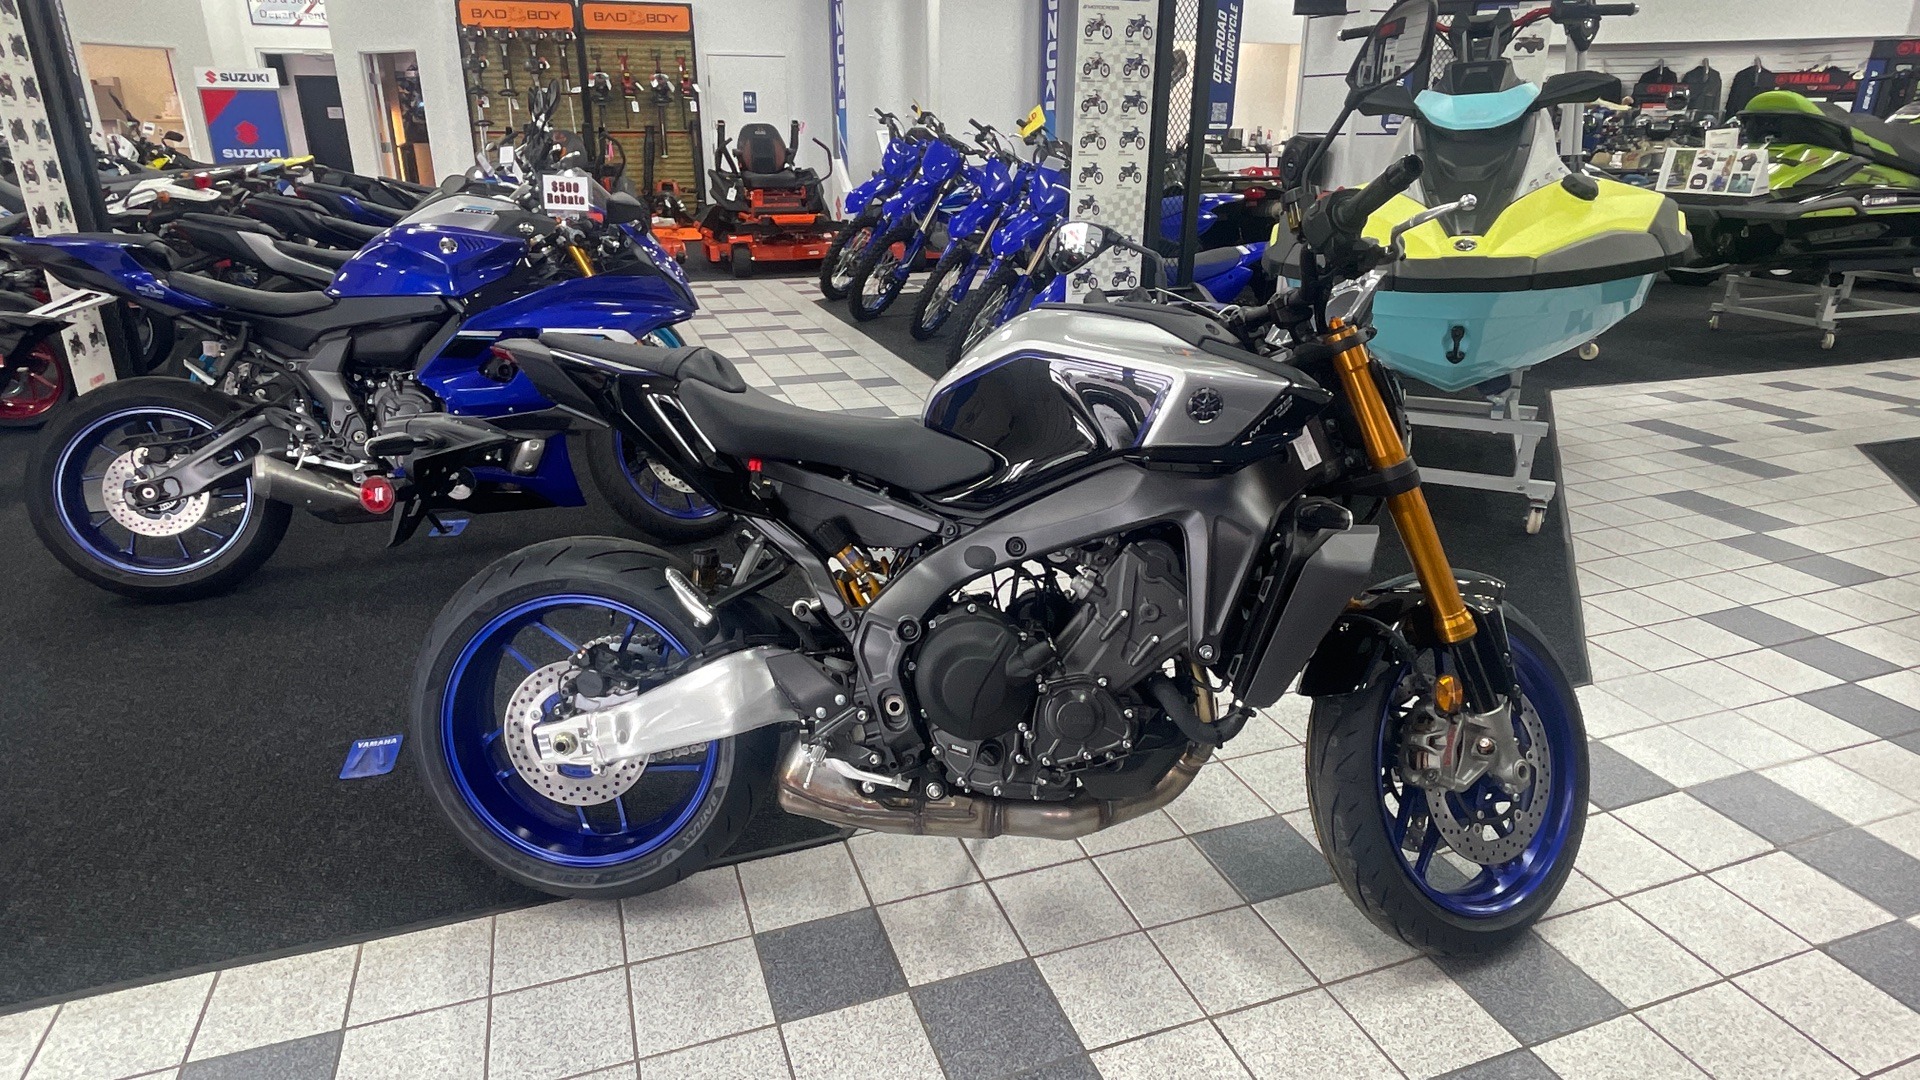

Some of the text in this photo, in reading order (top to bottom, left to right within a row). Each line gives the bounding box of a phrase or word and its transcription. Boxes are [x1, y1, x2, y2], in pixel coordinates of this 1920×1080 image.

[471, 8, 561, 21] BAD BOY
[593, 11, 679, 23] BAD BOY
[1212, 9, 1228, 84] OFF-ROAD
[1223, 2, 1239, 84] MOTORCYCLE
[836, 0, 845, 109] ZUKI
[220, 72, 269, 83] SUZUKI
[1788, 73, 1830, 84] YAMAHA
[222, 148, 281, 158] SUZUKI
[551, 180, 580, 194] $500
[546, 193, 585, 206] Rebate
[357, 738, 397, 749] YAMAHA
